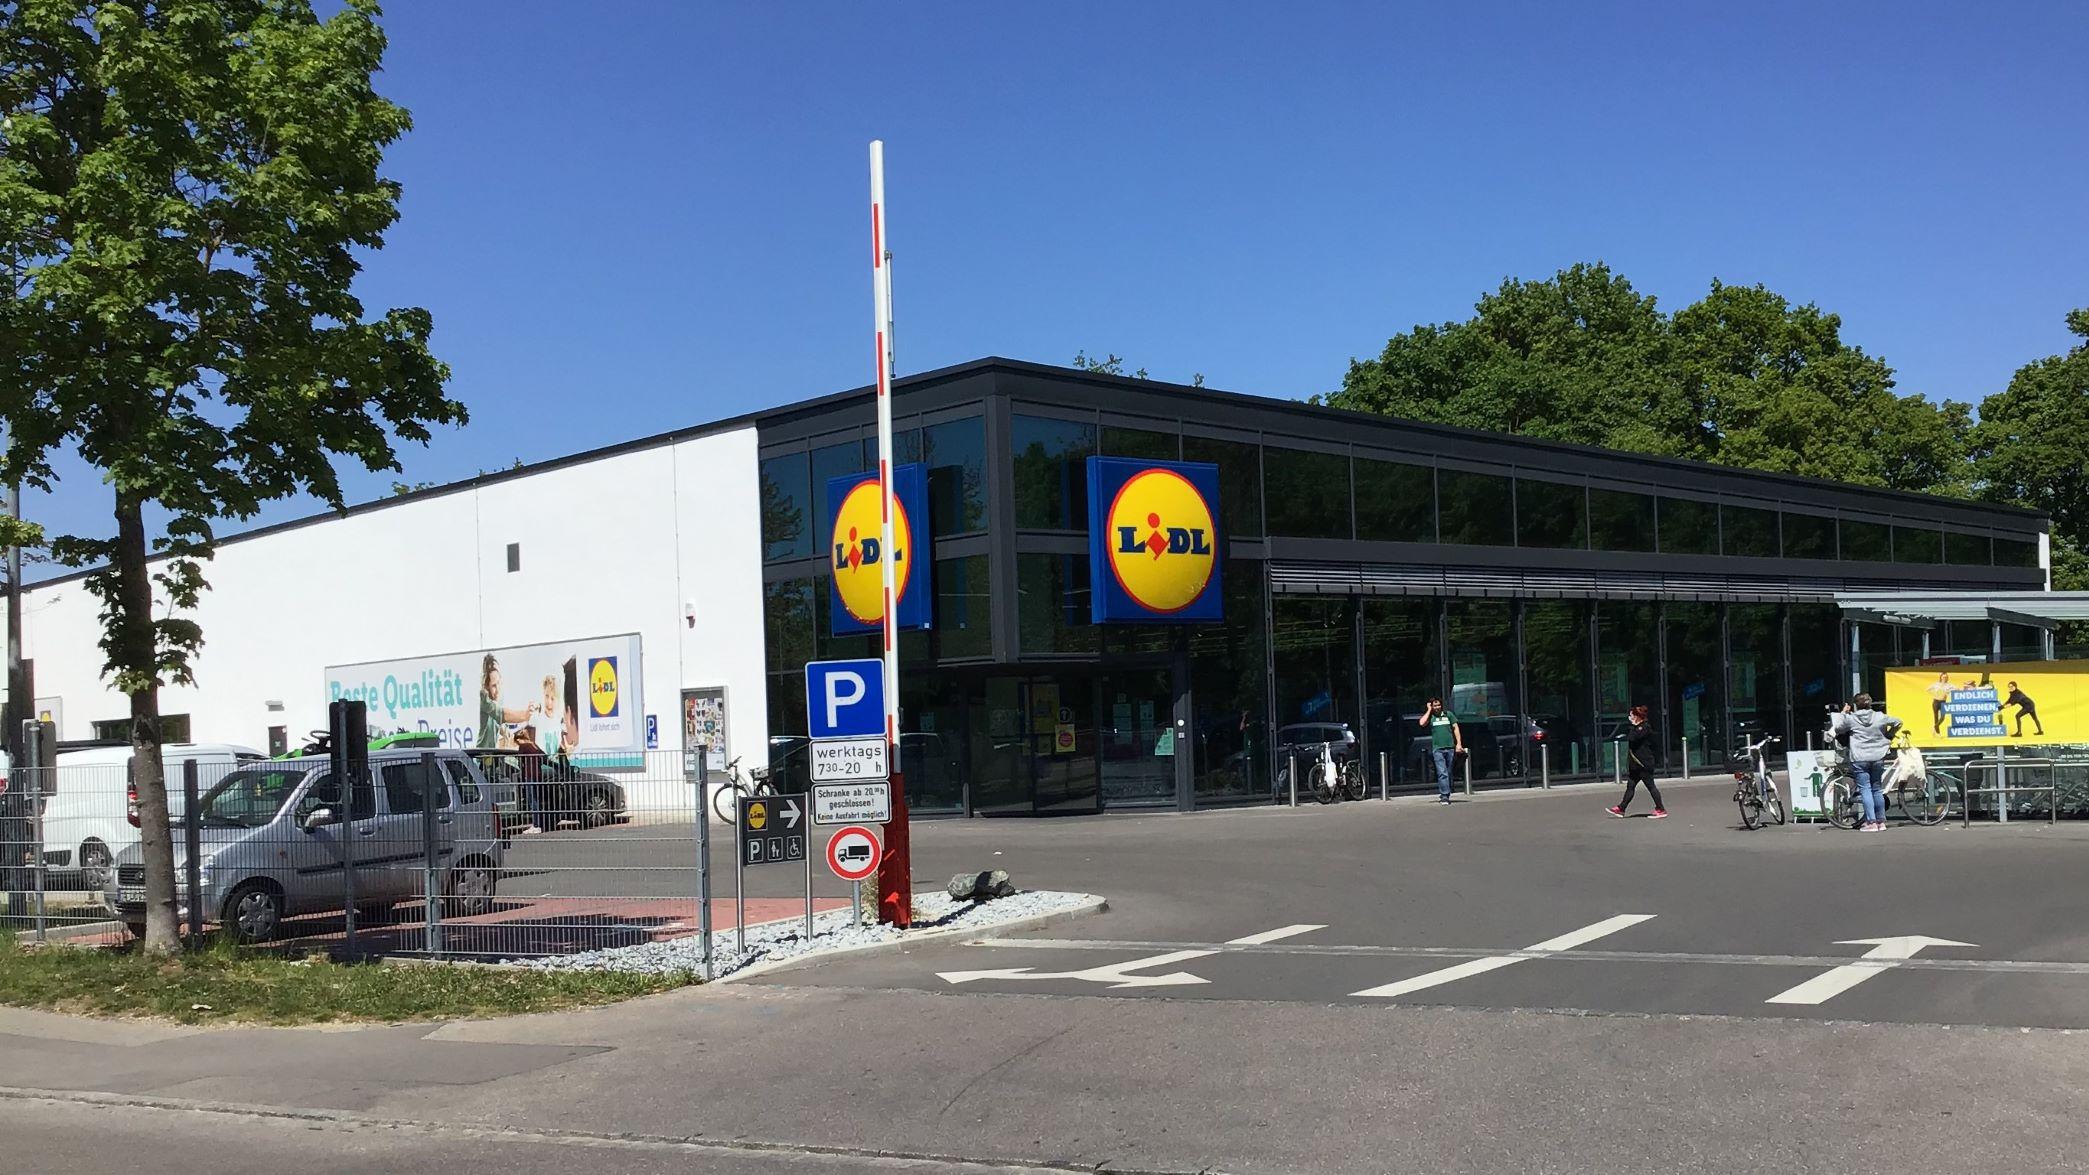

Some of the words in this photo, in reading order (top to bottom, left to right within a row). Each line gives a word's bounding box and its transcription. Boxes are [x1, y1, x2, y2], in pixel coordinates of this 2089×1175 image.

[383, 668, 463, 720] Qualität
[825, 671, 866, 728] P
[1954, 691, 1994, 700] ENDLICH
[1954, 716, 1976, 724] WAS
[1977, 715, 1991, 723] DU
[417, 718, 474, 749] eise
[1951, 727, 2004, 736] VERDIENST.
[817, 746, 882, 760] werktags
[875, 762, 882, 773] h
[817, 789, 850, 798] Schranke
[853, 788, 862, 797] ab
[829, 799, 874, 810] geschlossen!
[835, 812, 860, 820] Ausfahrt
[750, 841, 760, 861] P
